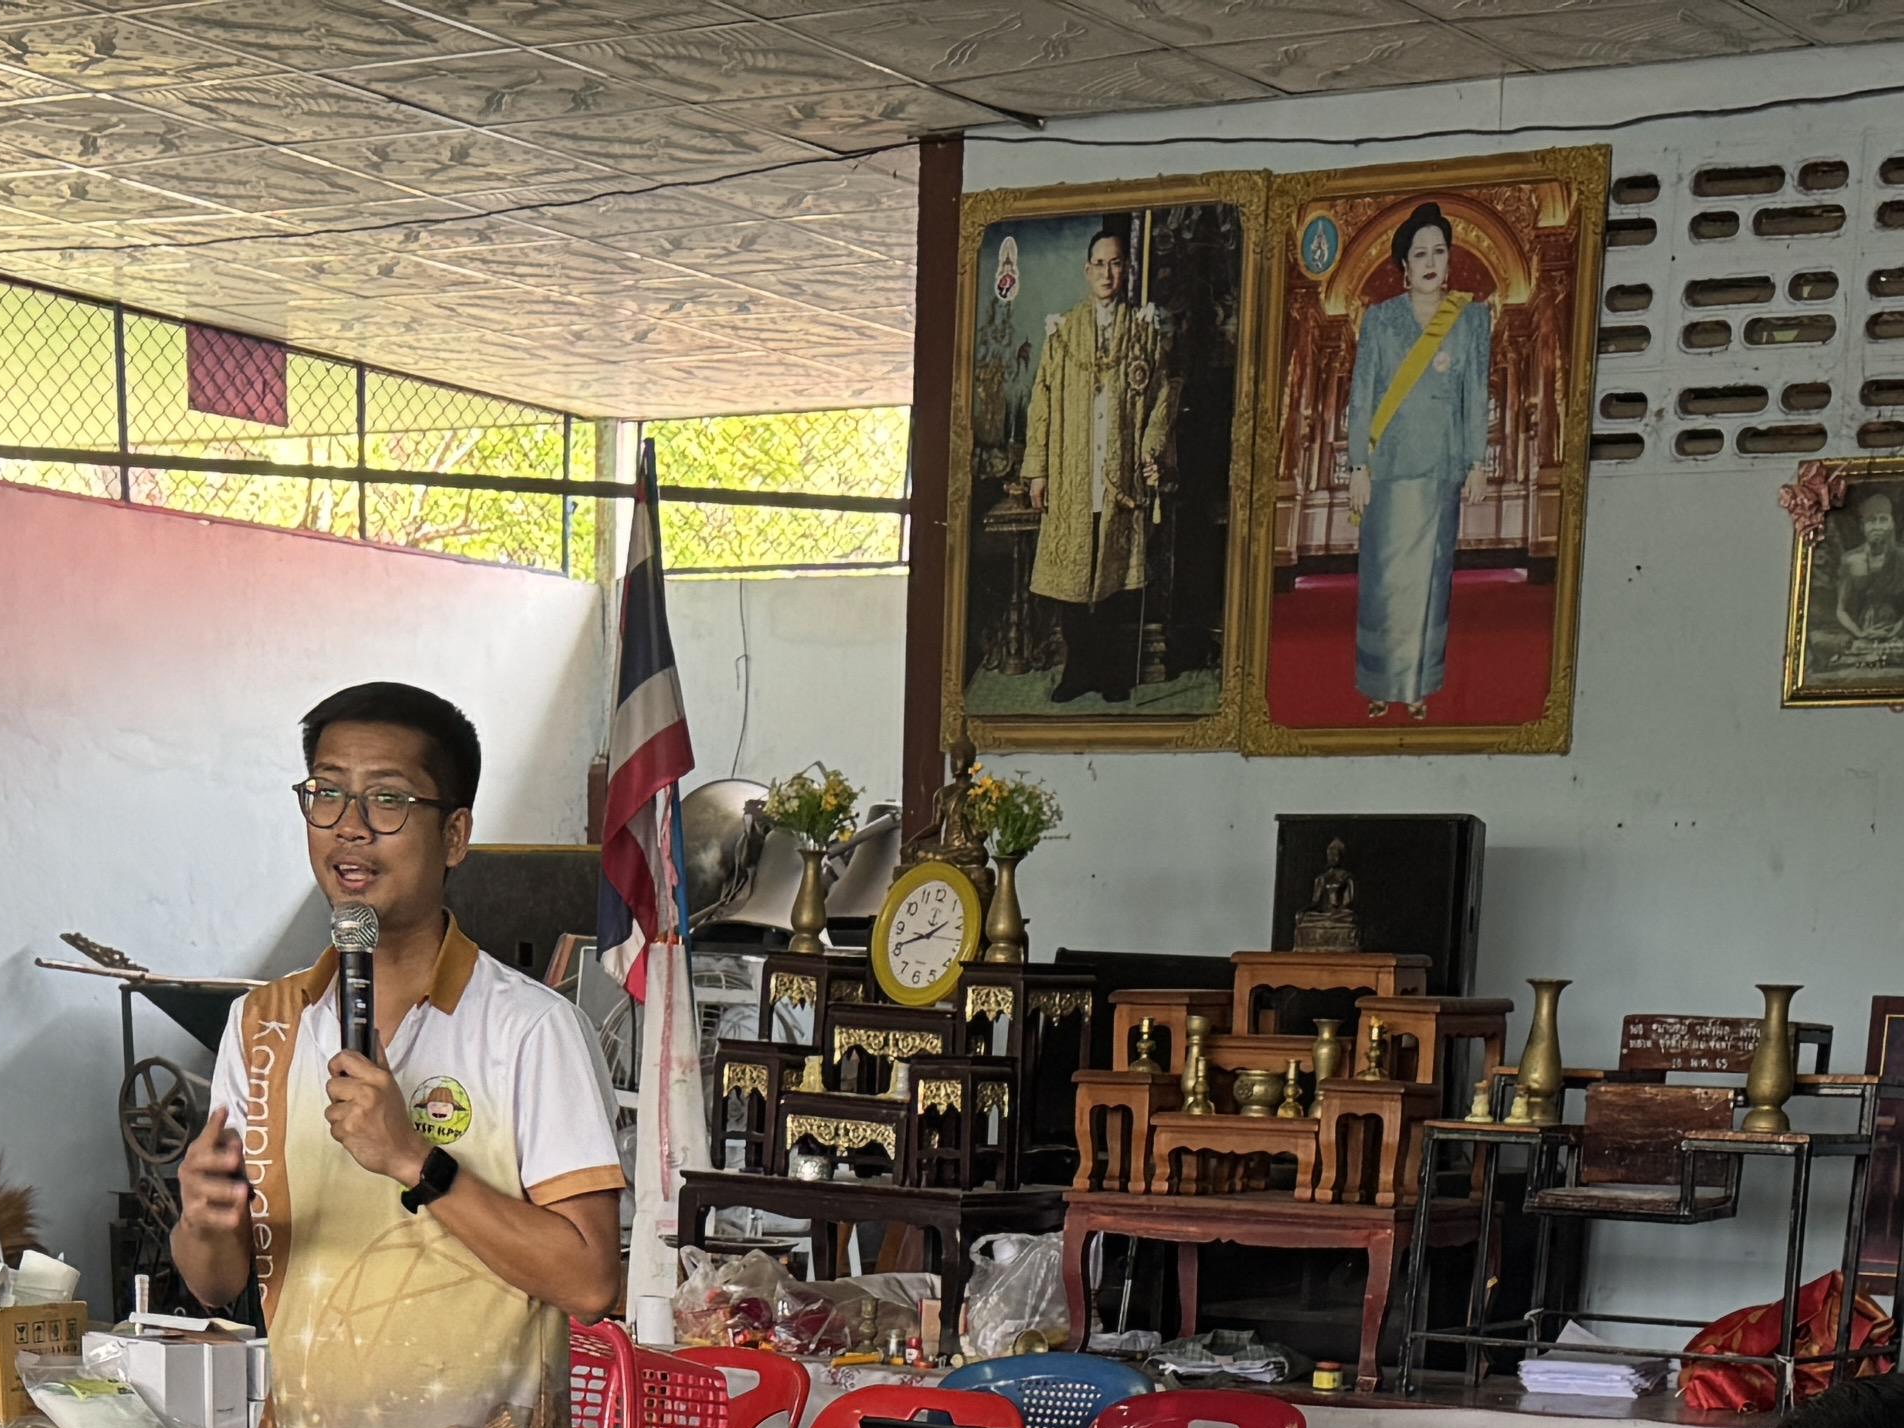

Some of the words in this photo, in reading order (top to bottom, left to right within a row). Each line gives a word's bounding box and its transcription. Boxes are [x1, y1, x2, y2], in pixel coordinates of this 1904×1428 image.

[921, 889, 930, 904] 11
[935, 888, 947, 903] 12
[896, 921, 905, 935] 9
[901, 961, 909, 975] 7
[912, 971, 921, 984] 6
